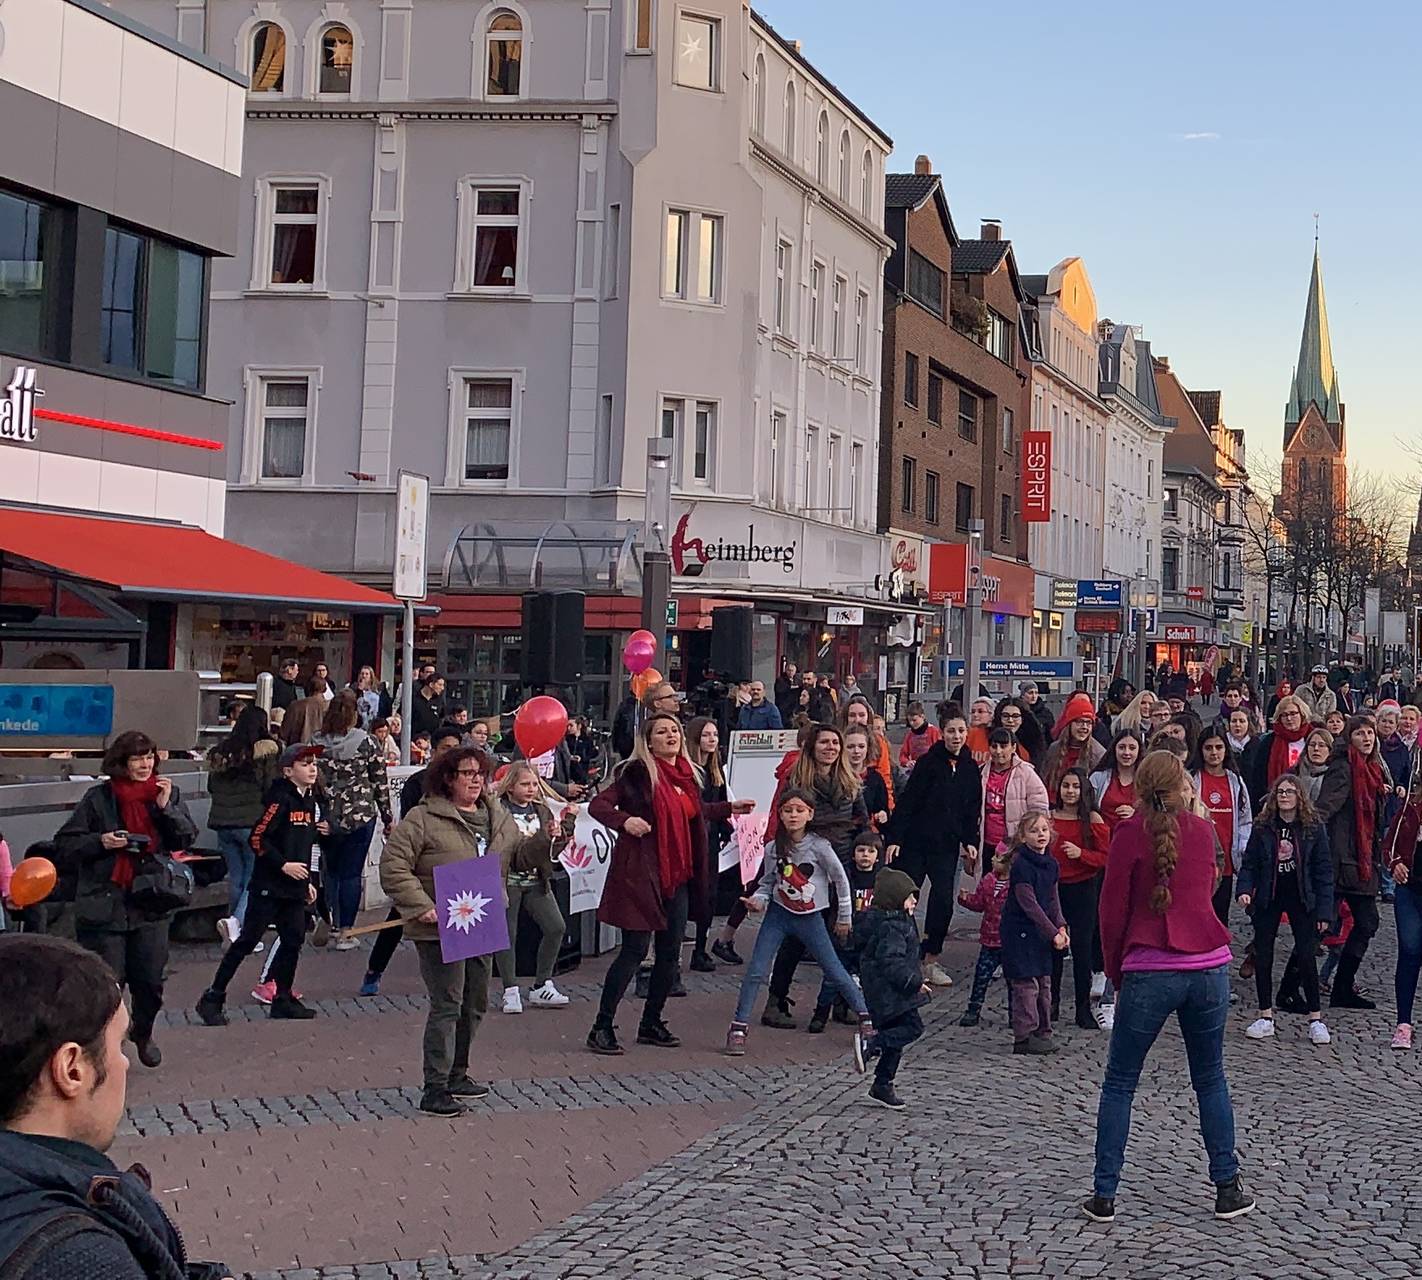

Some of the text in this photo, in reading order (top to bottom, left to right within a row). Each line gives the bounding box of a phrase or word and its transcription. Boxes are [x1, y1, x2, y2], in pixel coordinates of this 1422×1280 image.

[1027, 441, 1046, 512] ESPRIT
[931, 590, 963, 600] ESPRIT
[1009, 662, 1030, 670] Mitte
